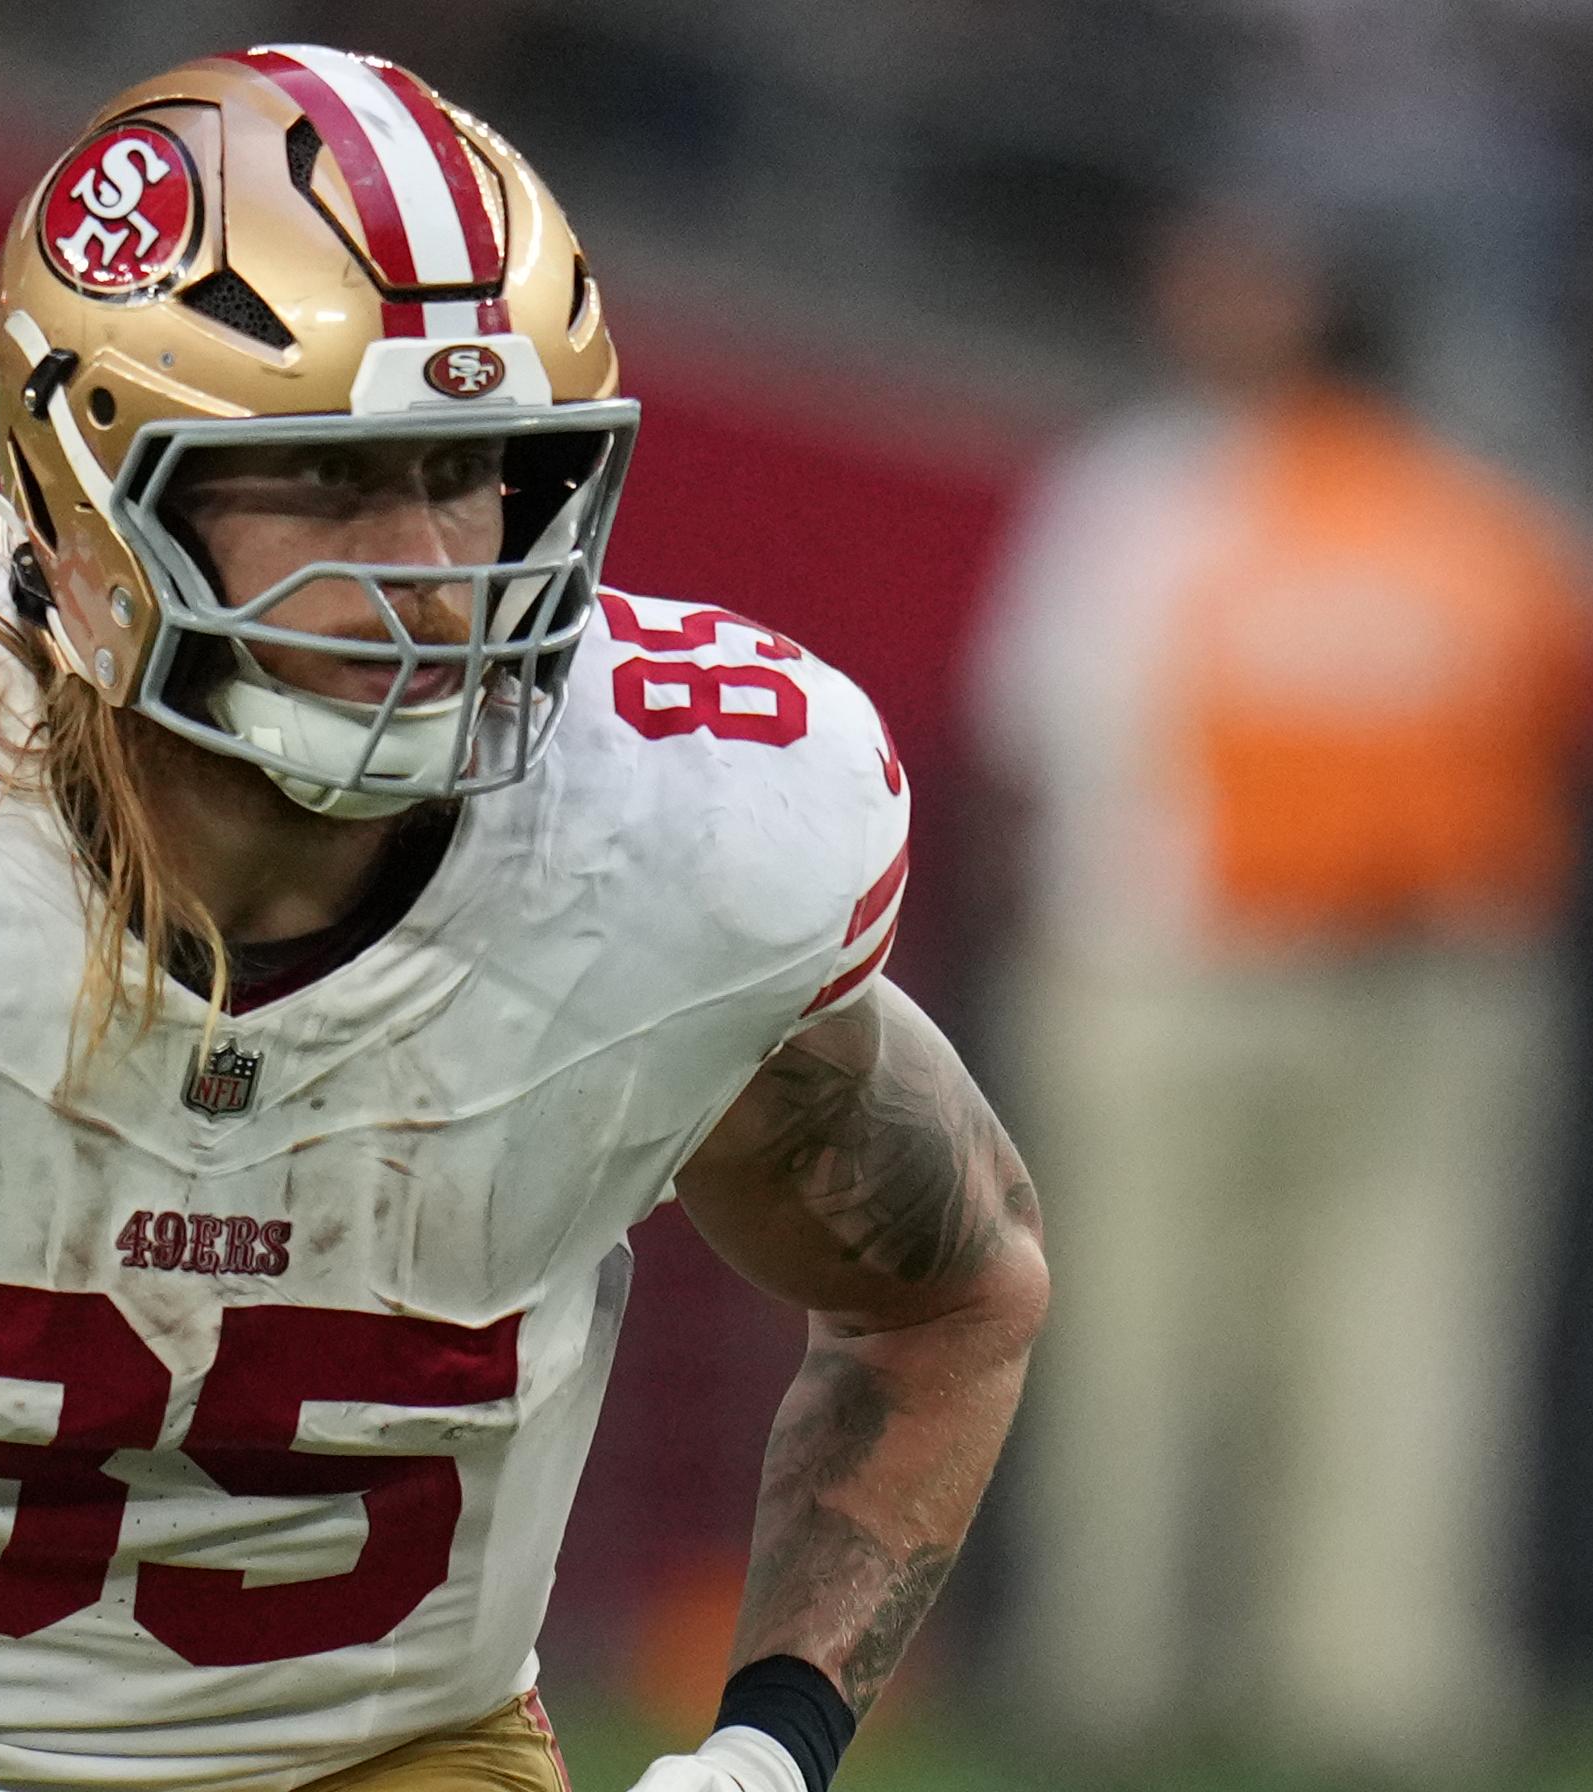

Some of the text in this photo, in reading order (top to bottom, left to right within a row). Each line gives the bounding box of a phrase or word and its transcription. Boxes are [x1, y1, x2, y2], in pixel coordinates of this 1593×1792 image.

[597, 593, 806, 748] 85
[191, 1076, 242, 1109] NFL
[115, 1210, 293, 1277] 49ERS
